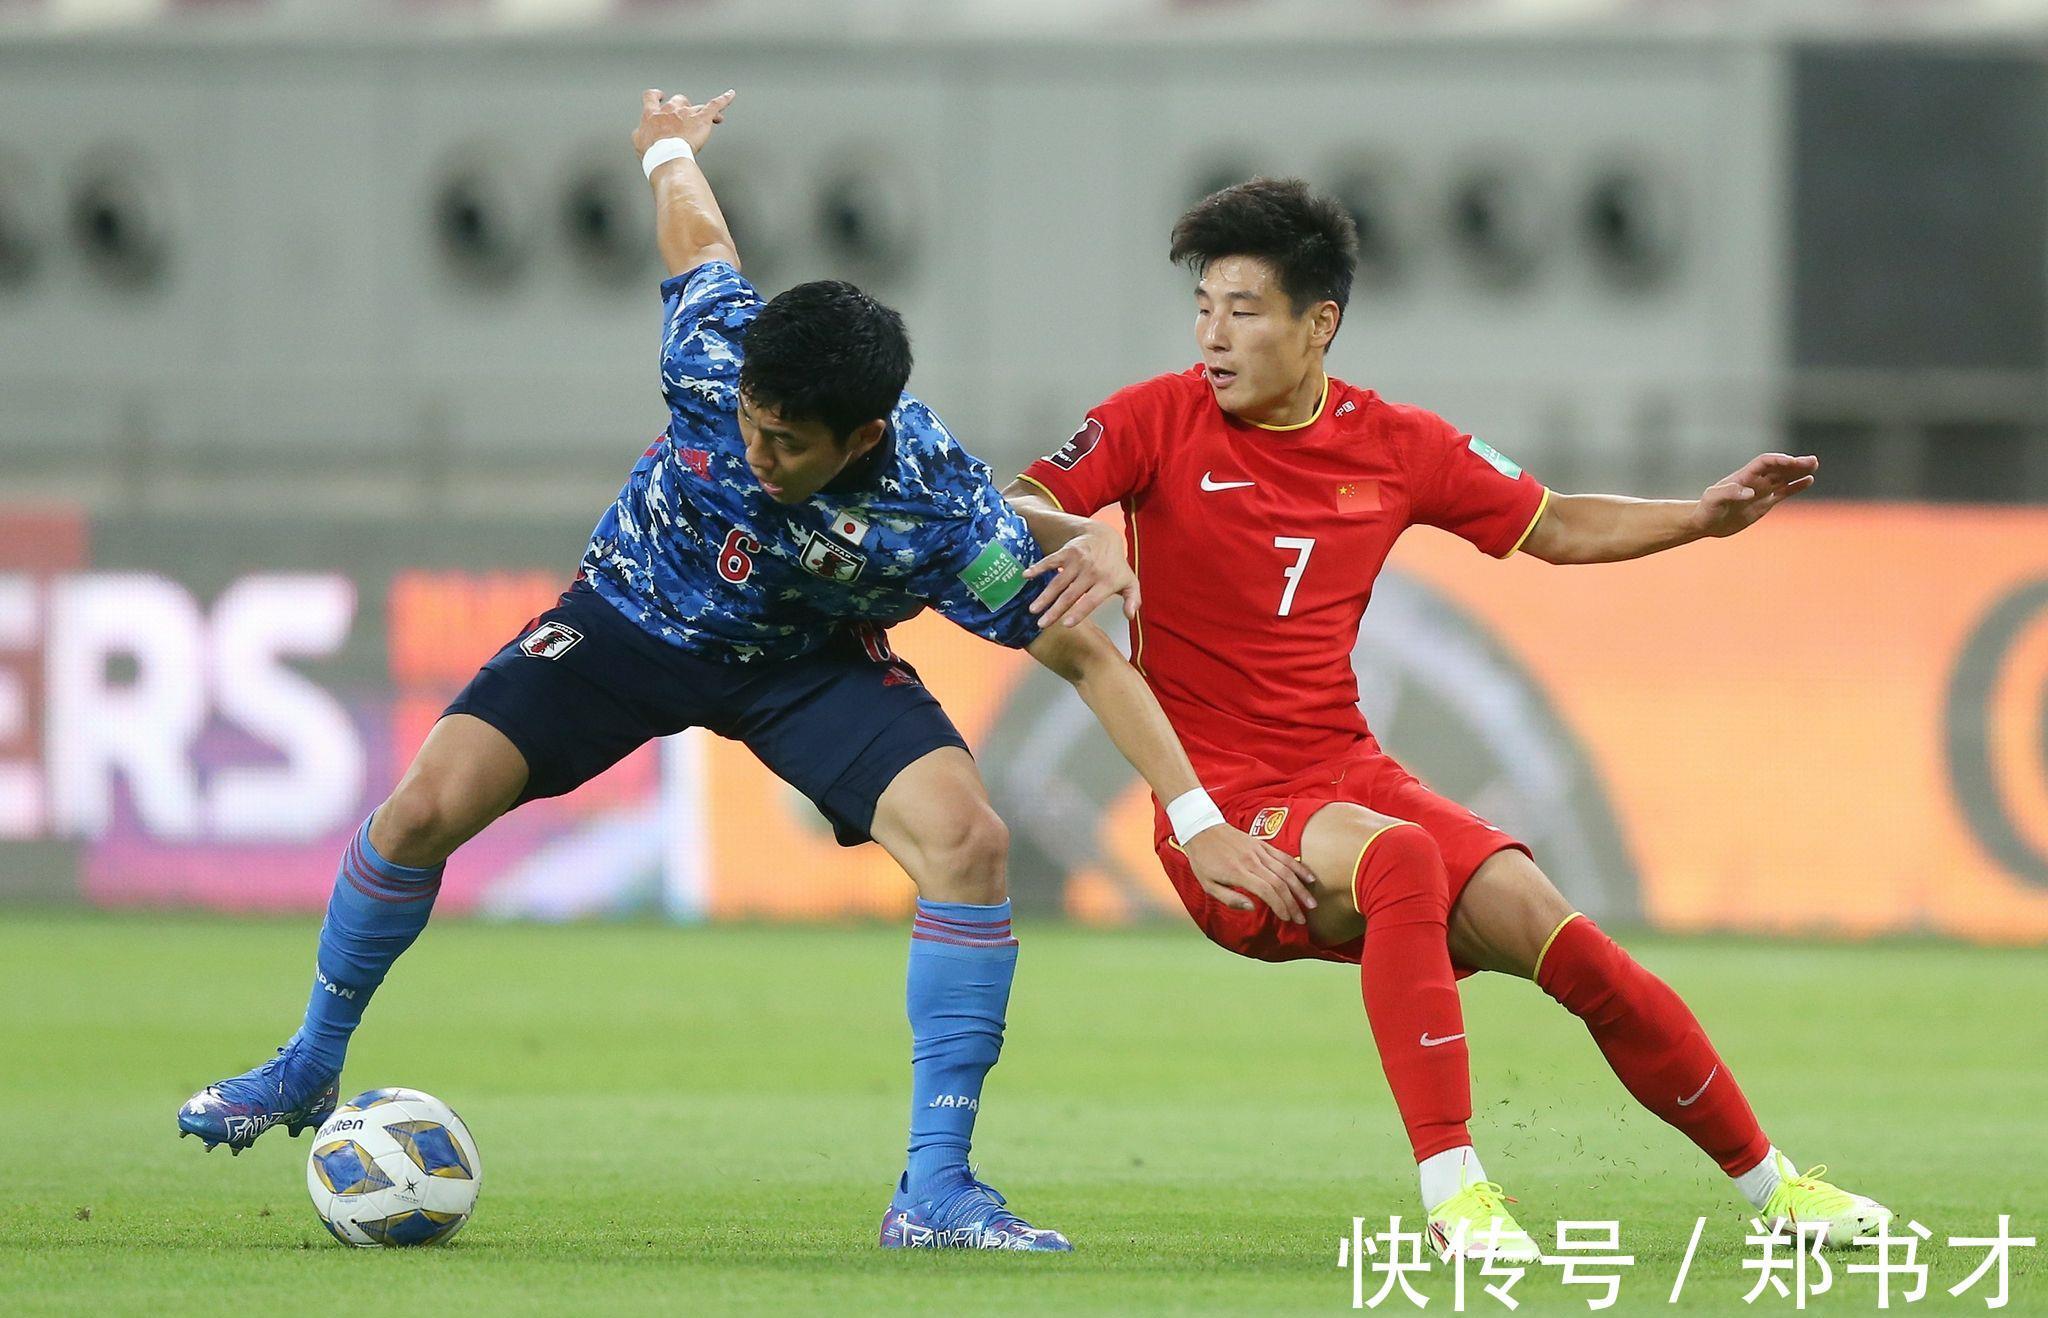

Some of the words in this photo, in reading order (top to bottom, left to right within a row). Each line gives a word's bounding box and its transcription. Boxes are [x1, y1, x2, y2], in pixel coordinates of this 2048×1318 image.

[717, 528, 761, 584] 6
[824, 541, 852, 559] JAPAN
[1273, 536, 1316, 617] 7
[553, 624, 575, 636] JAPAN
[316, 1119, 364, 1142] molten
